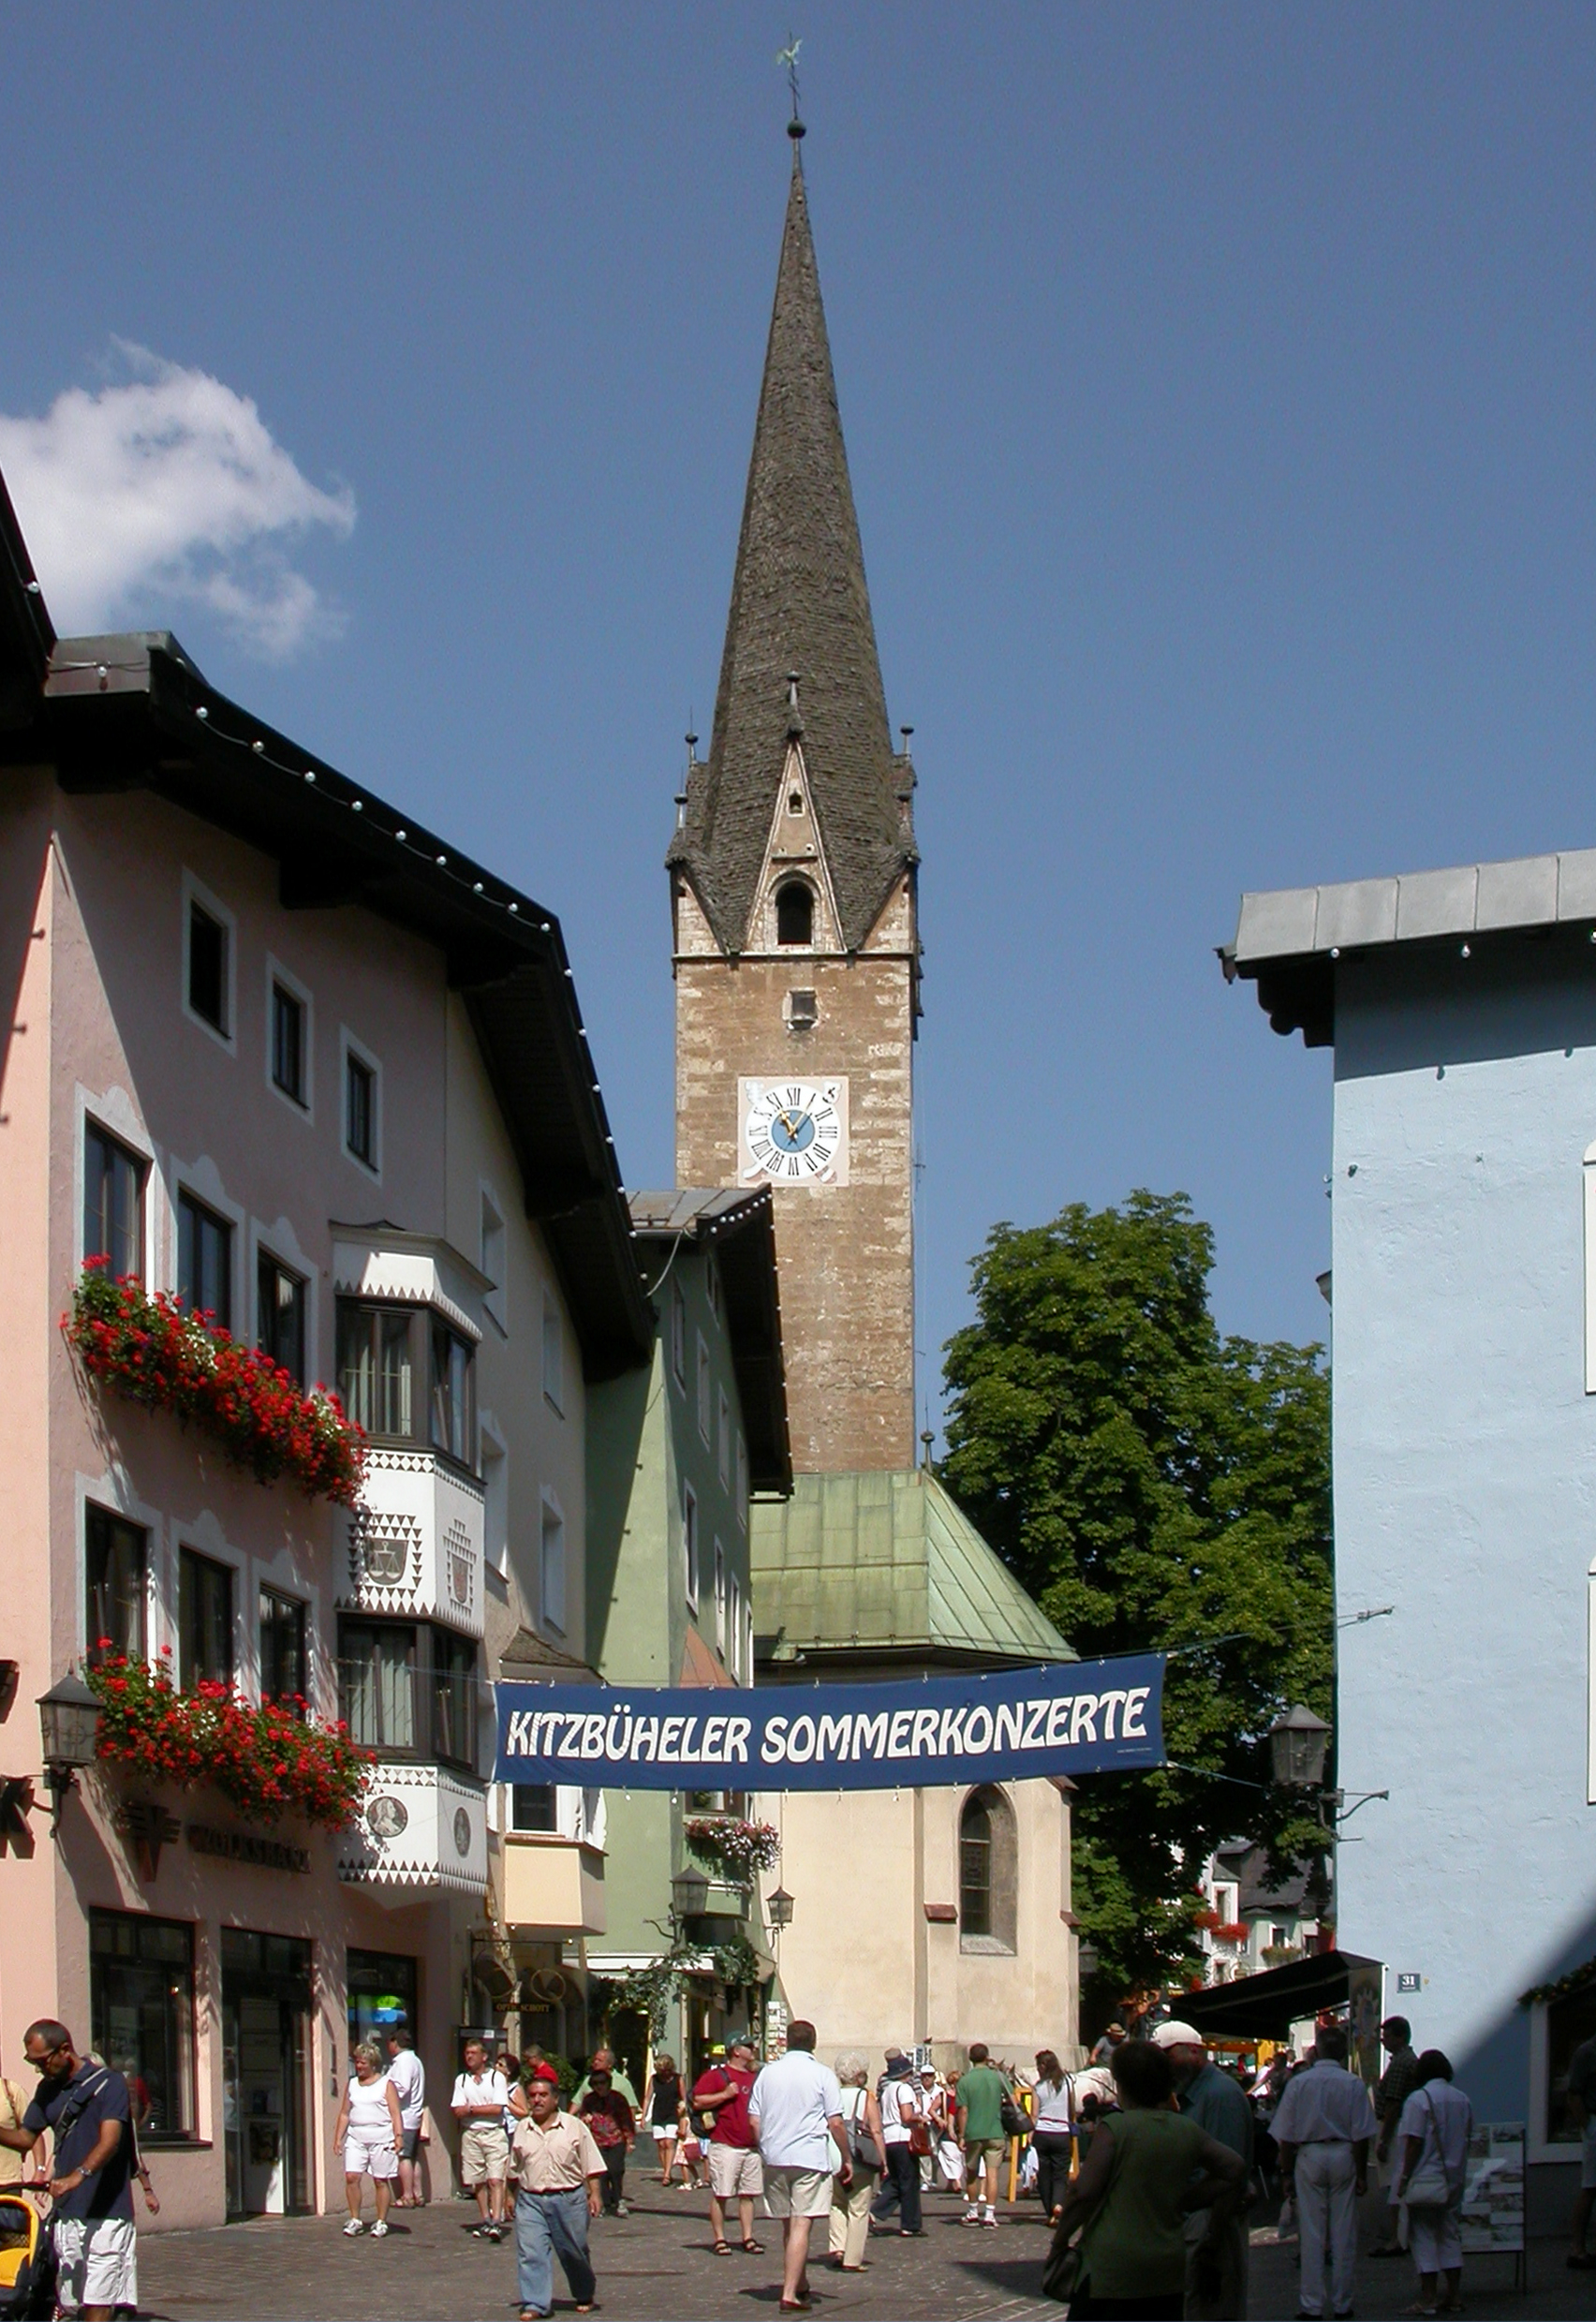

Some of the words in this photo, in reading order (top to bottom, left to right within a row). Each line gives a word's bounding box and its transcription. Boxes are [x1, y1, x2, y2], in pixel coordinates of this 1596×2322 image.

[506, 1703, 751, 1763] KITZBÜHELER
[761, 1687, 1151, 1764] SOMMERKONZERTE
[1401, 1974, 1415, 1986] 31
